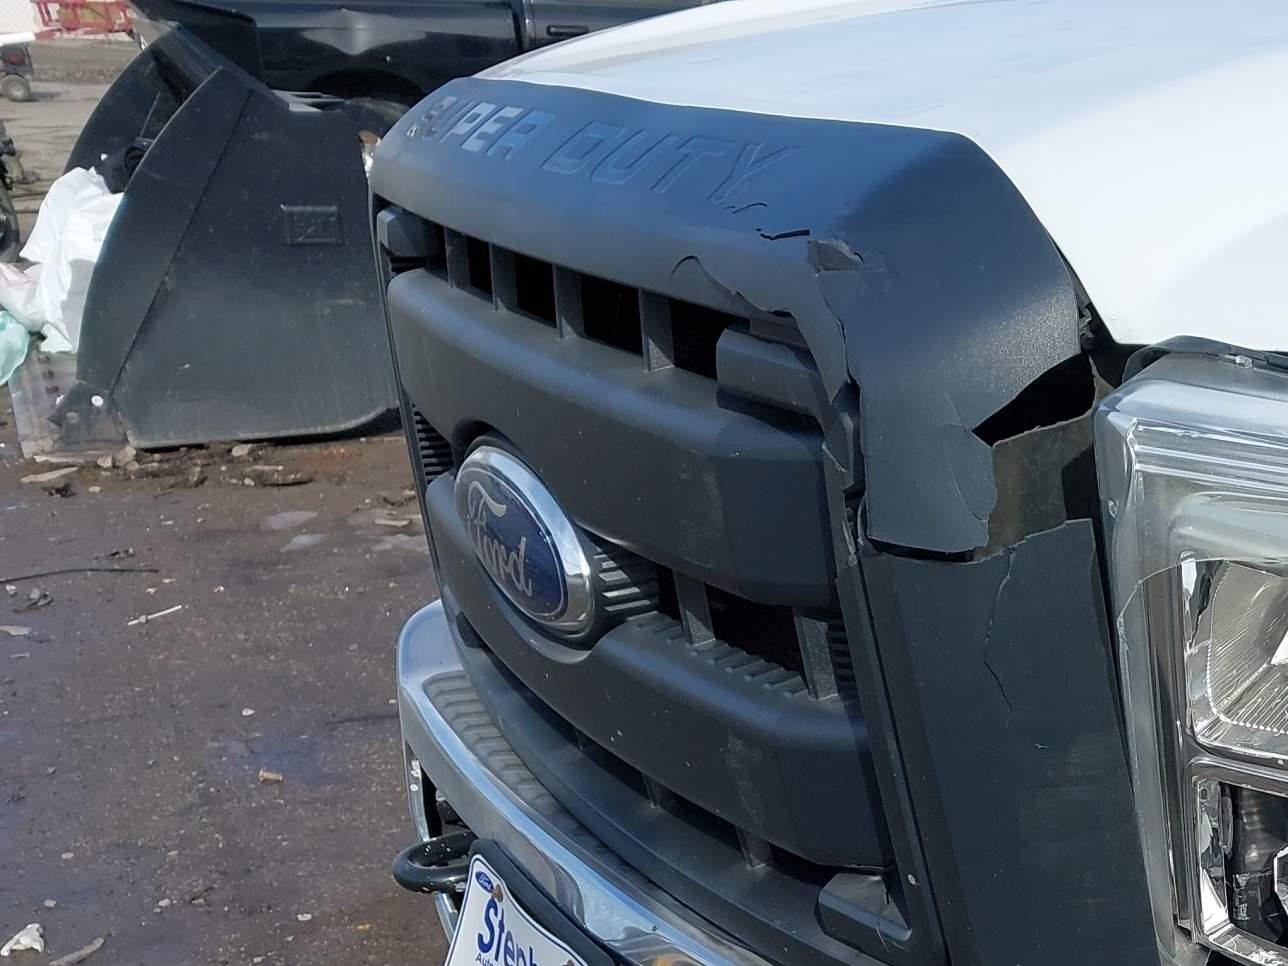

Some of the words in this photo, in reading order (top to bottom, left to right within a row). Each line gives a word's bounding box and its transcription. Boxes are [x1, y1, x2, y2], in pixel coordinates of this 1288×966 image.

[421, 96, 556, 160] SUPER
[539, 119, 801, 201] DUTY
[468, 480, 533, 597] Ford
